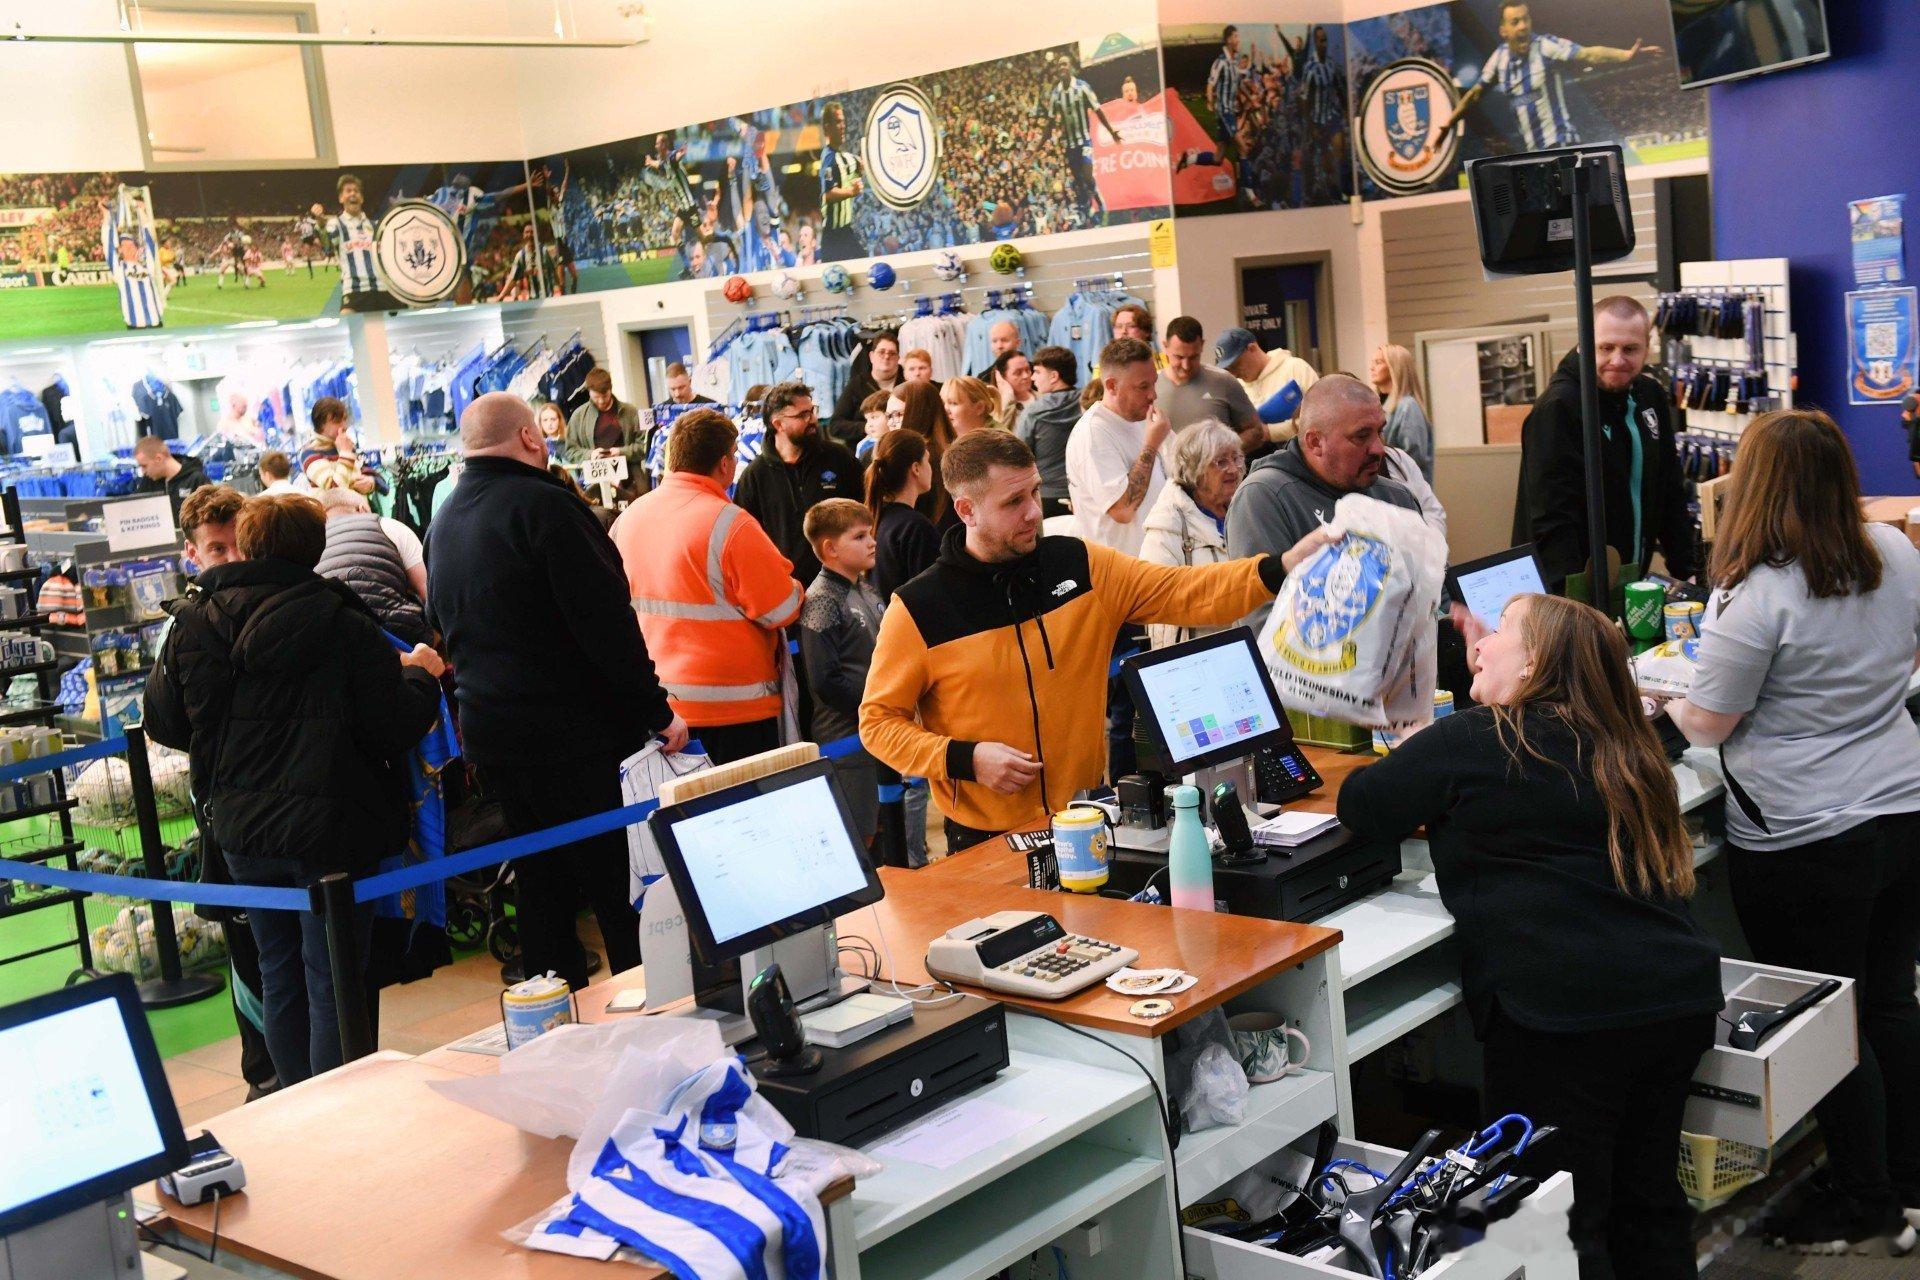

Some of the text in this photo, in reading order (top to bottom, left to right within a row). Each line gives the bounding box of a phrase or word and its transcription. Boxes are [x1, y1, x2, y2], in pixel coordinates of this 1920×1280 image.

[1119, 150, 1170, 170] GOIN
[0, 212, 24, 223] LEY
[591, 469, 608, 478] OFF
[120, 515, 160, 526] PIN BADGES
[127, 522, 161, 532] KEYRINGS
[1295, 676, 1358, 704] WEDNESDAY
[1032, 856, 1041, 888] #ITSOK
